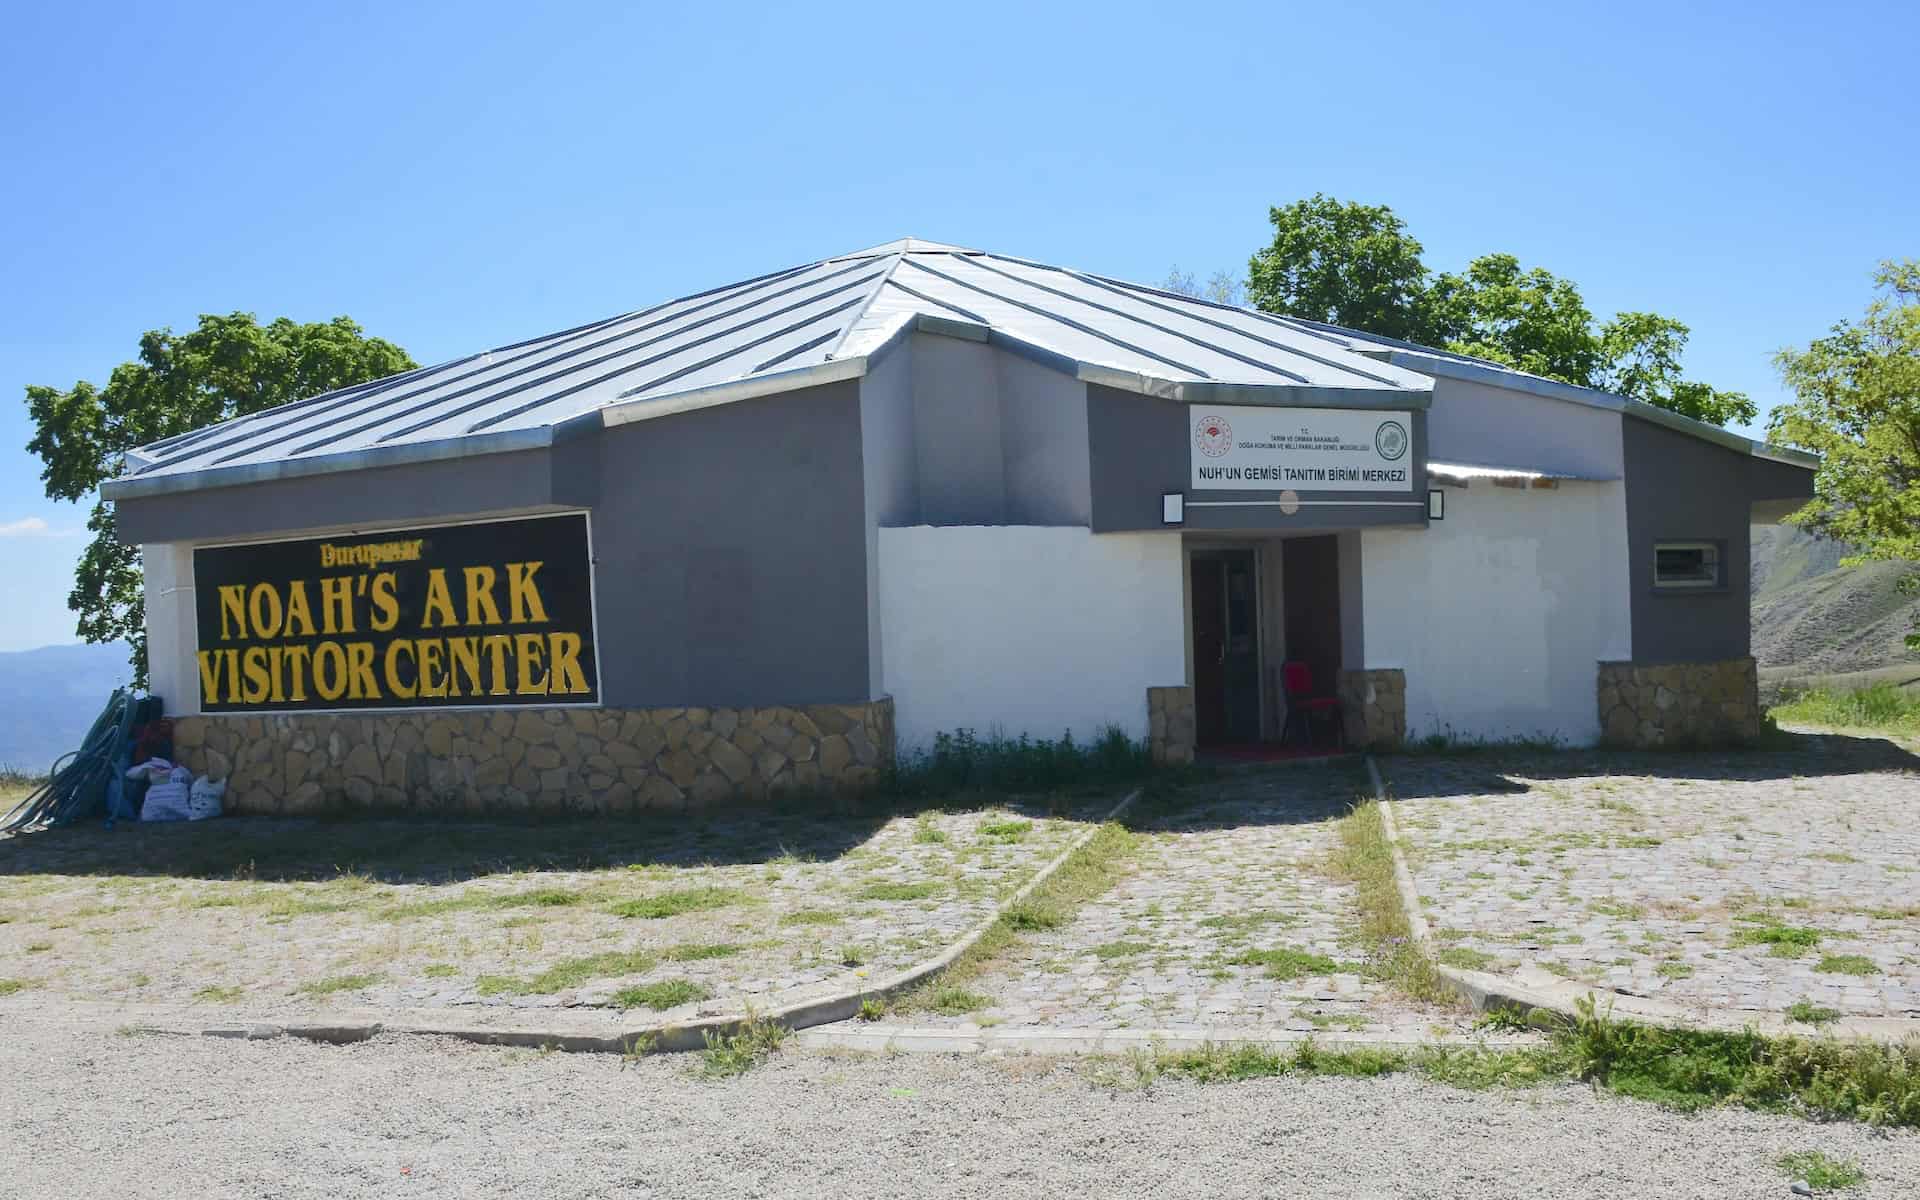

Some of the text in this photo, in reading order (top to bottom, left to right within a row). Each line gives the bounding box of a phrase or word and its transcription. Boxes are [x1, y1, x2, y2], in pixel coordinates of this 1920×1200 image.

[1199, 465, 1406, 482] NUH'UN GEMİSİ TANITIM BİRİMİ MERKEZİ
[218, 561, 549, 641] NOAH'S ARK
[197, 631, 592, 705] VISITOR CENTER
